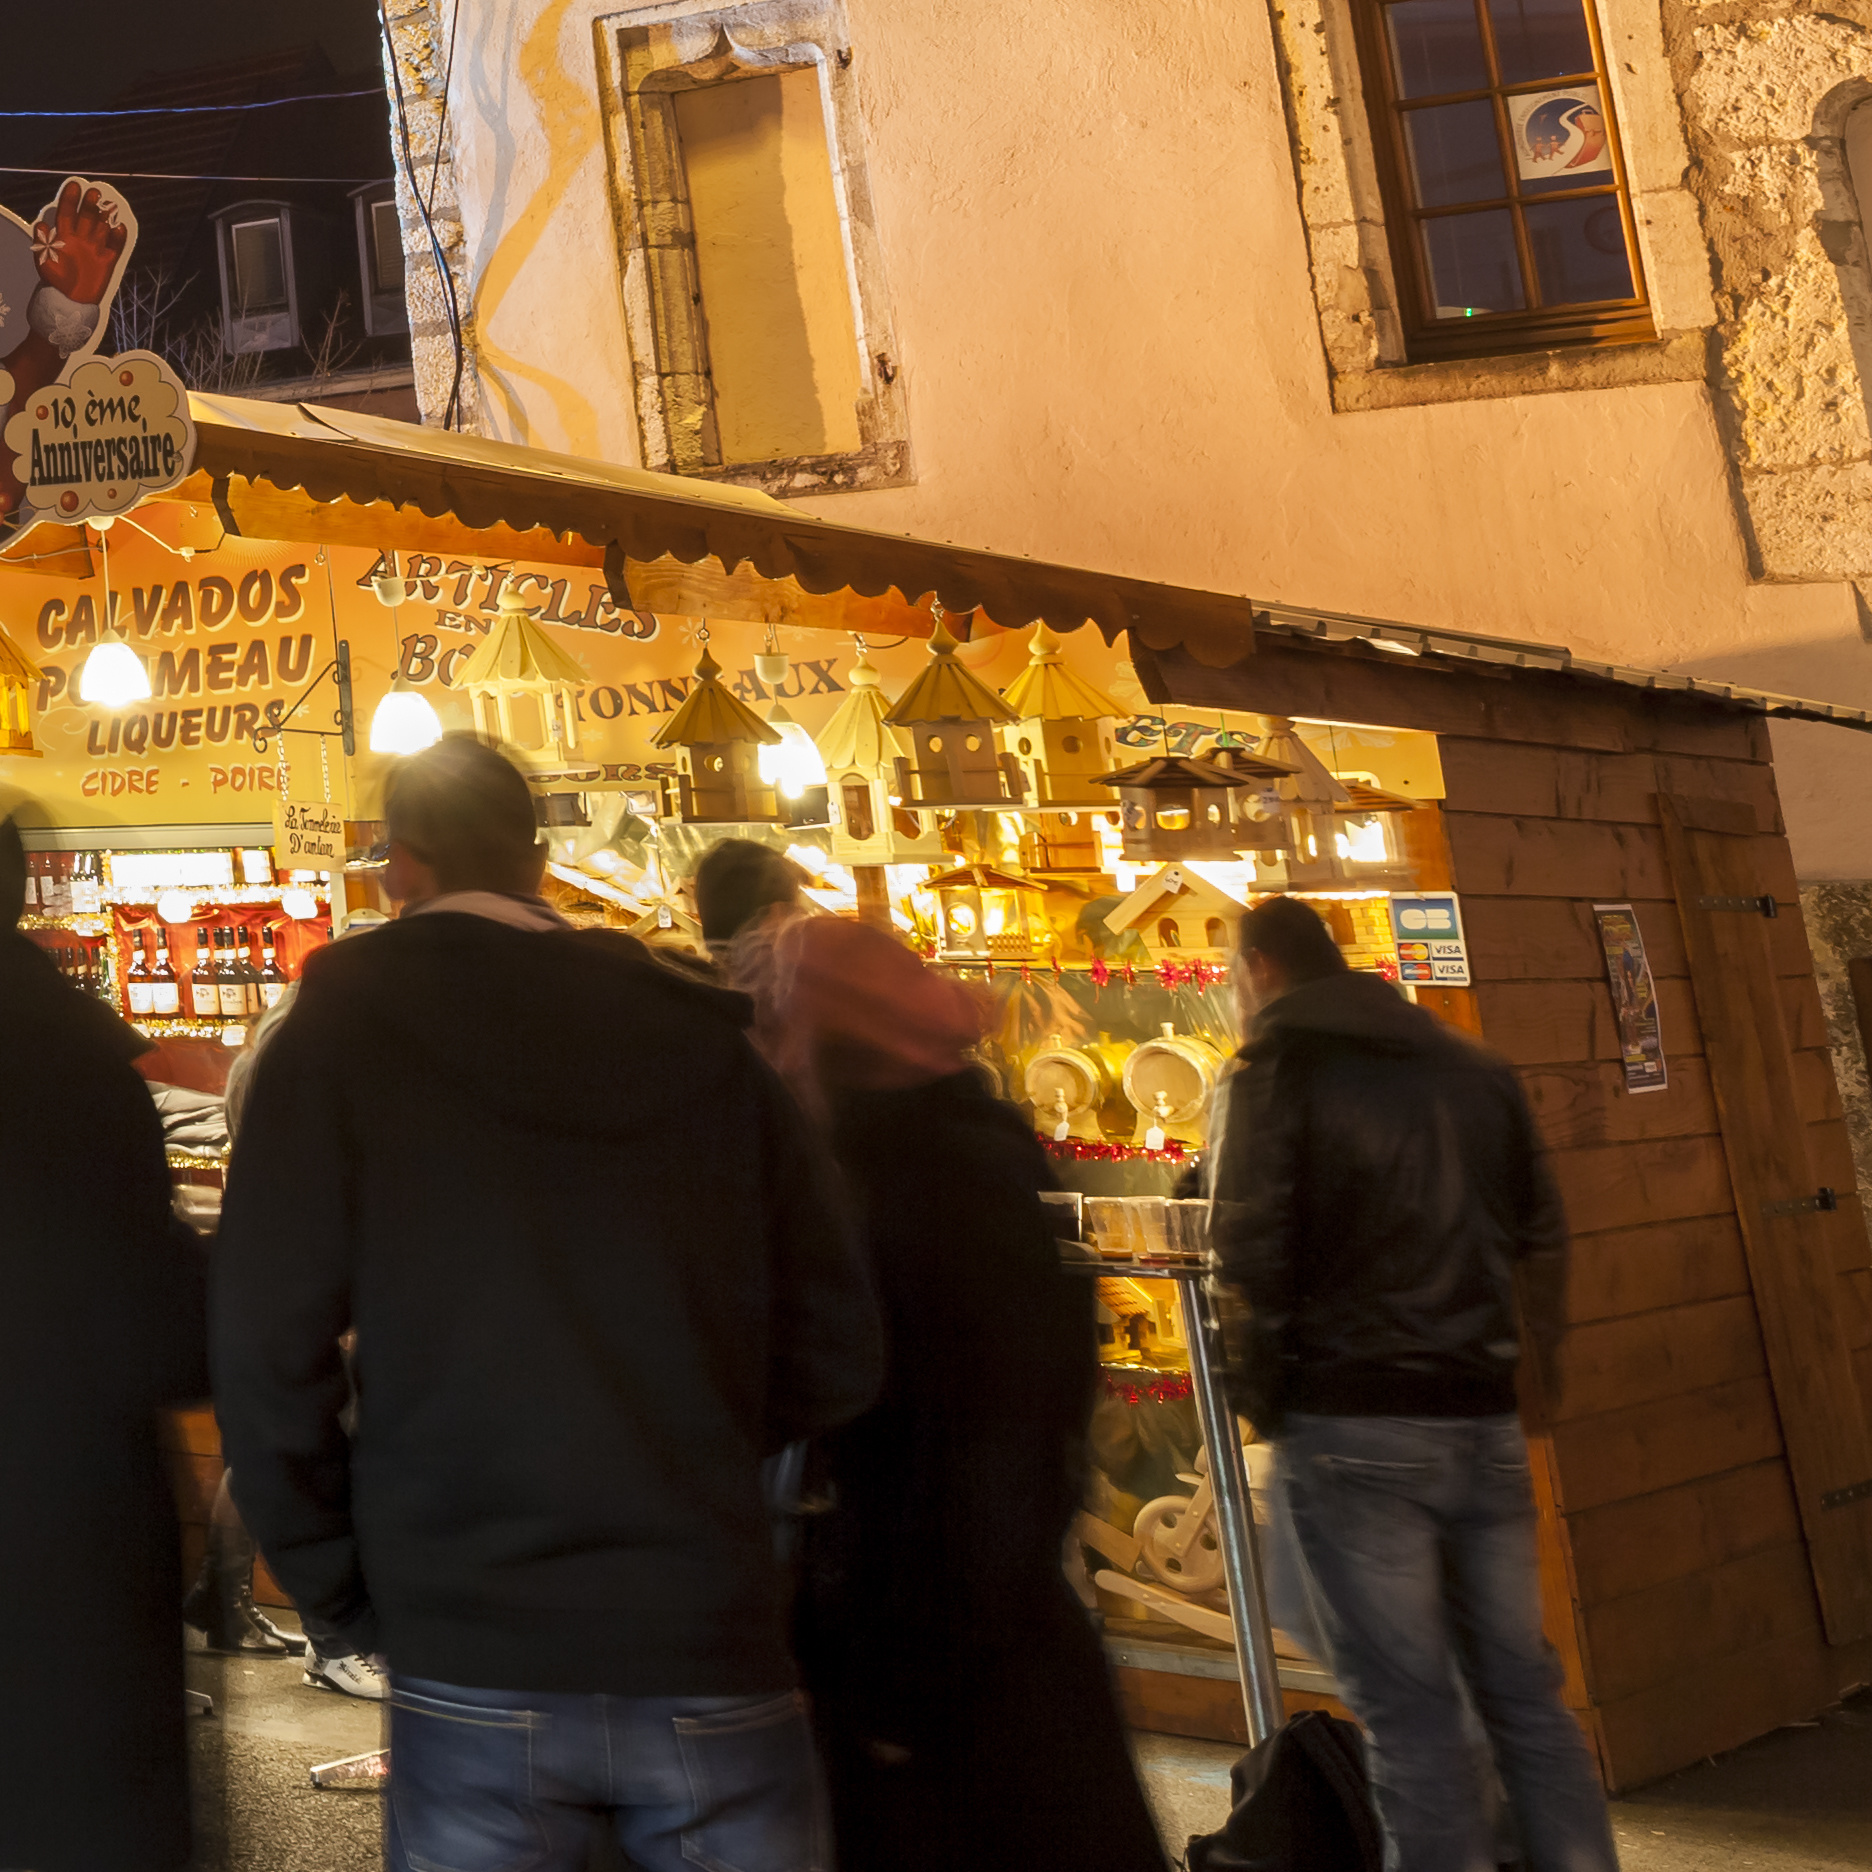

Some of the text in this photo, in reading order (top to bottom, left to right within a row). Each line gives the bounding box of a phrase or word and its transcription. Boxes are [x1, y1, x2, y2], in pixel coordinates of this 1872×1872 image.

[51, 390, 141, 429] 10 ème
[30, 417, 176, 486] Anniversaire
[37, 564, 309, 651] CALVADOS
[435, 609, 492, 635] EN
[87, 699, 286, 756] LIQUEURS
[81, 767, 160, 797] CIDRE
[1400, 908, 1452, 930] CB
[1435, 945, 1462, 955] VISA
[1438, 965, 1465, 975] VISA
